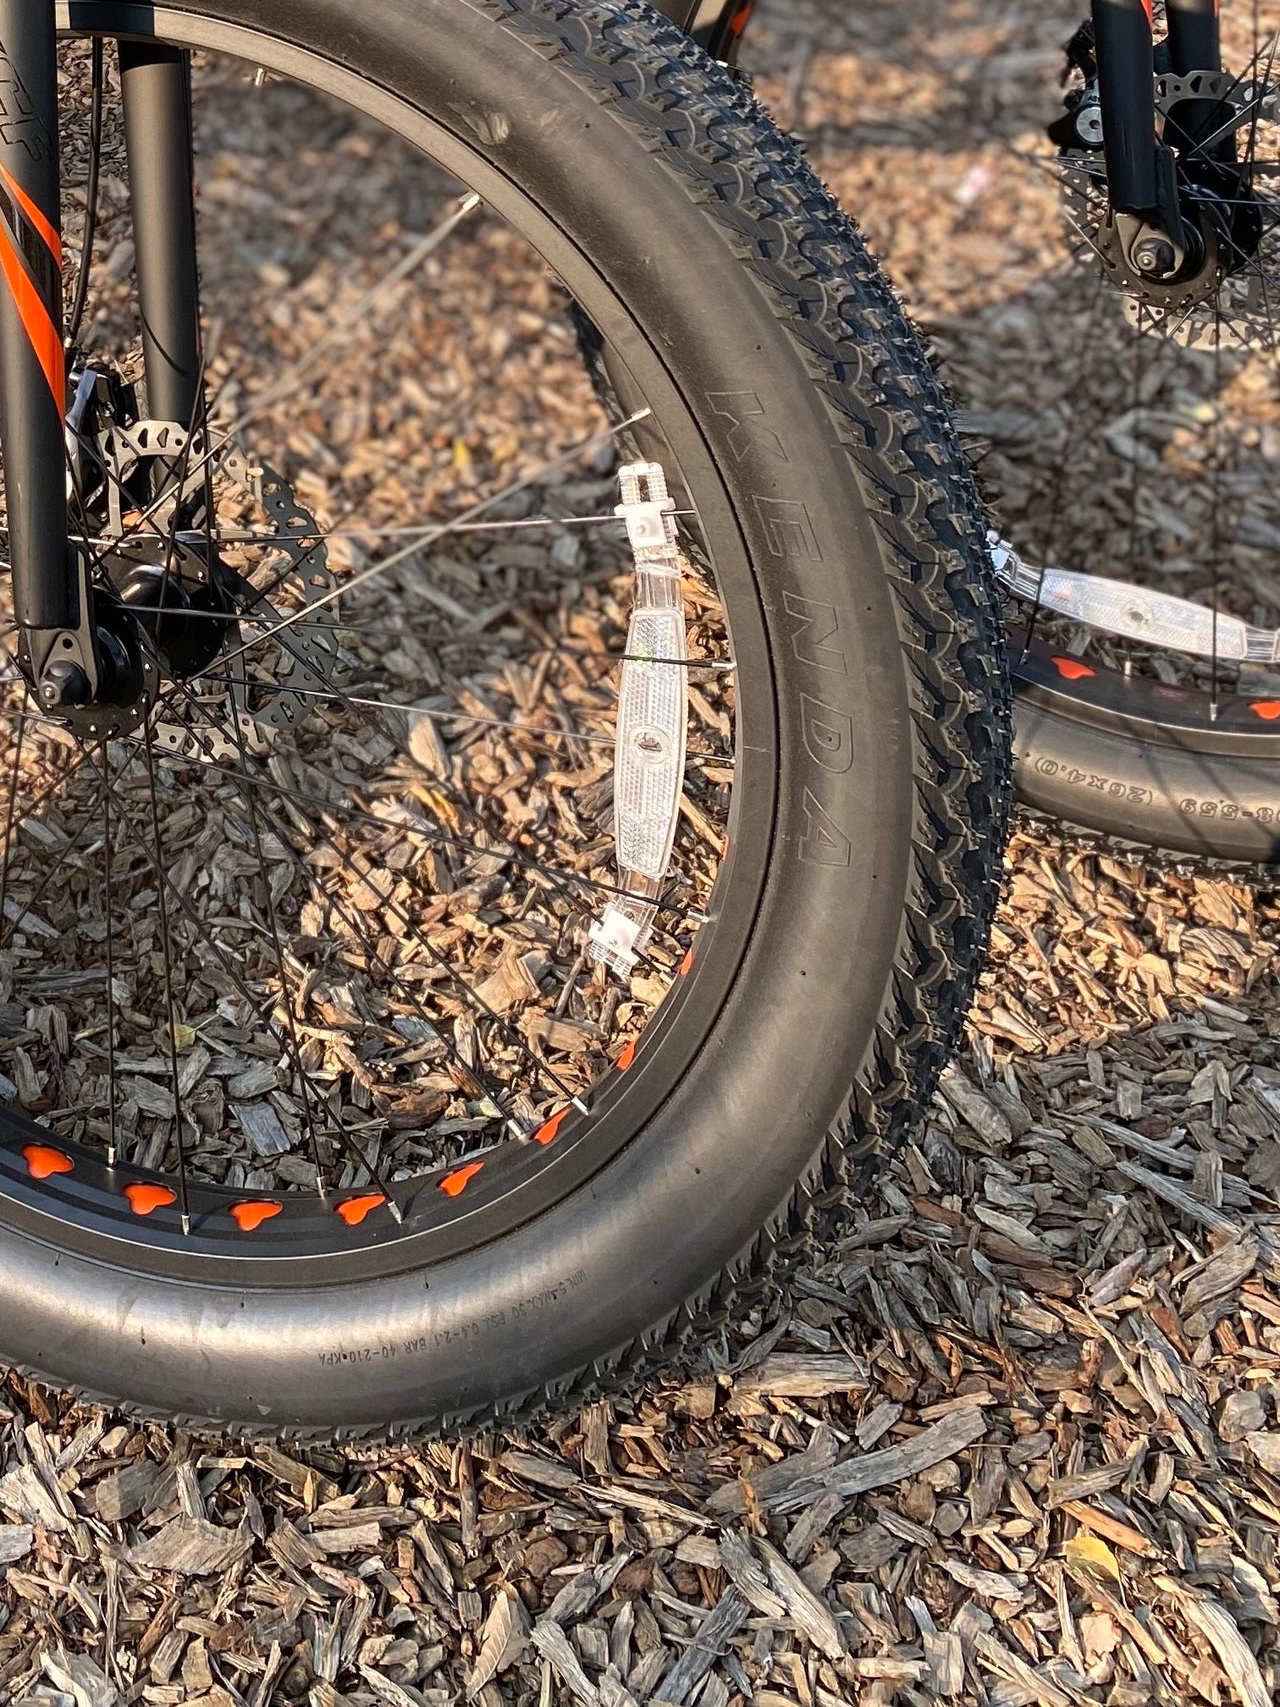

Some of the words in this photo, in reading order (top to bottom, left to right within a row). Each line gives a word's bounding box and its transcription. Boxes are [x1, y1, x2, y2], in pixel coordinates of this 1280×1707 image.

[705, 388, 856, 868] KENDA
[1034, 756, 1153, 806] (26x4.0)
[1178, 796, 1280, 825] 8-559
[317, 1352, 343, 1366] KPA
[402, 1337, 428, 1353] BAR
